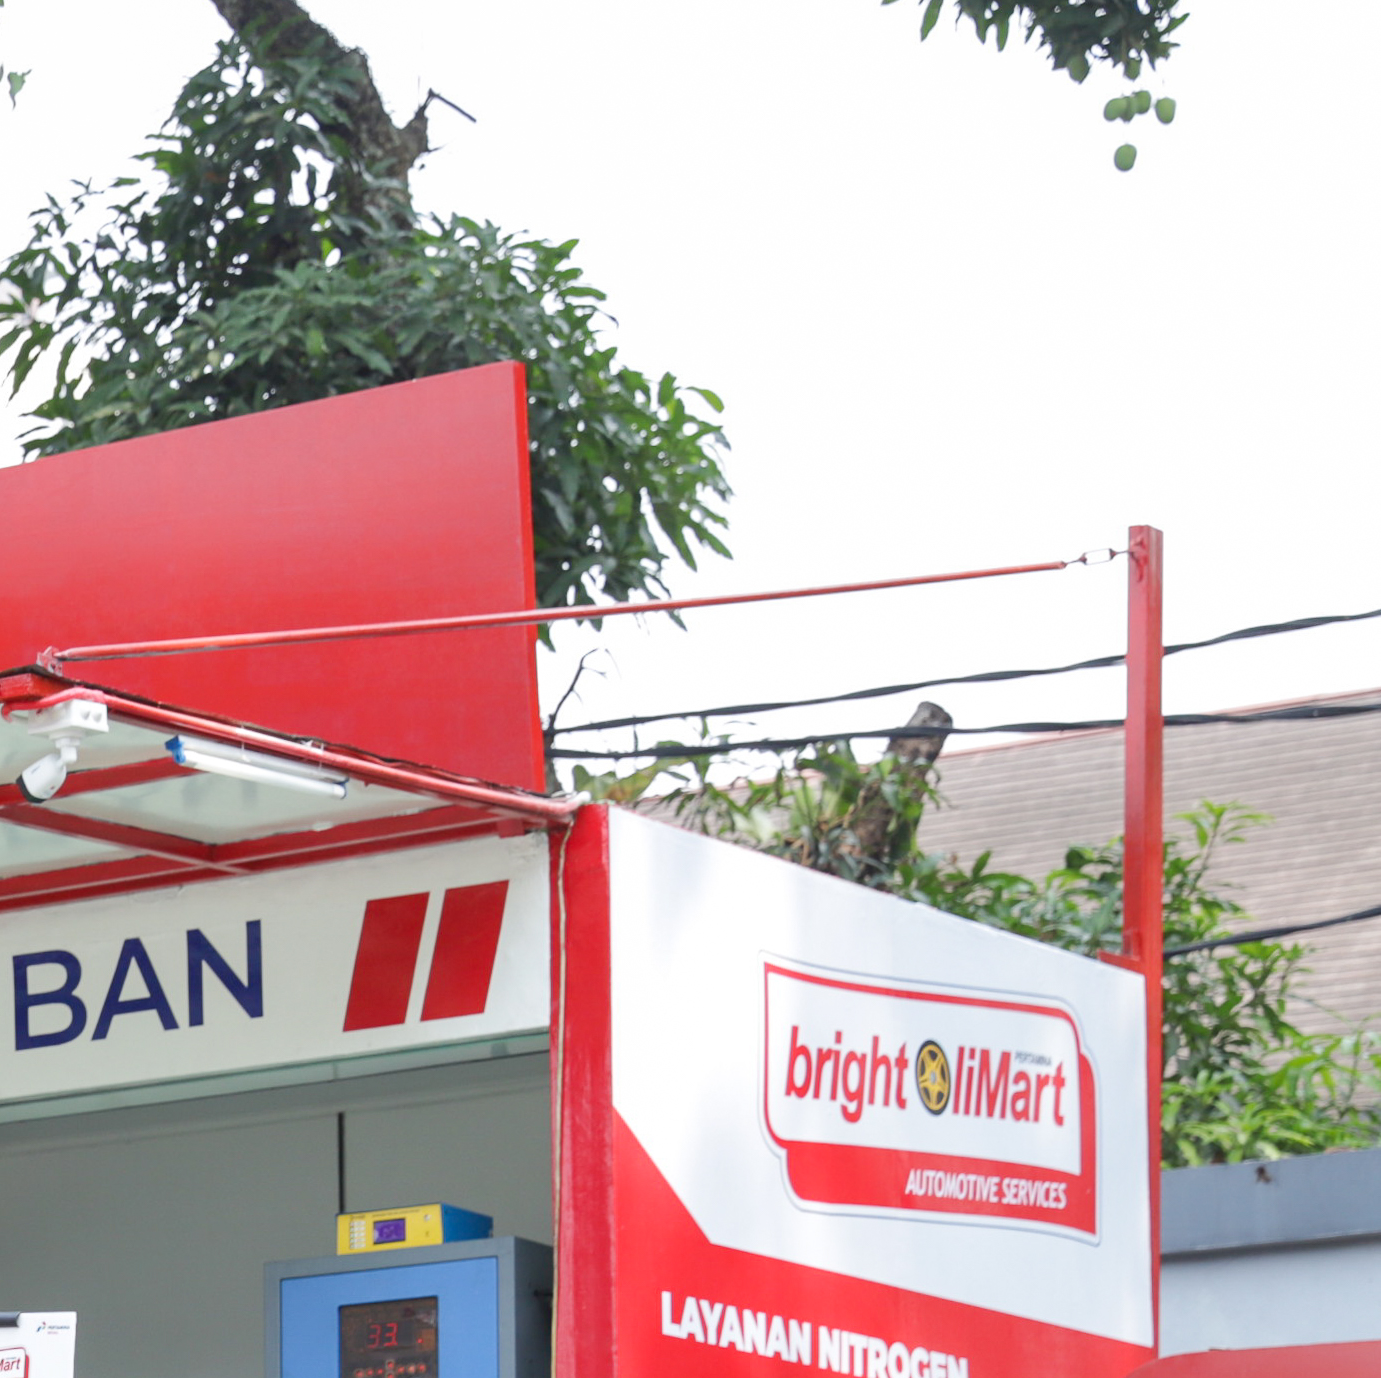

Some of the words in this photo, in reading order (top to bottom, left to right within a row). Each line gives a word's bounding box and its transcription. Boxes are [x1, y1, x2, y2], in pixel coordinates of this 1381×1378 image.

[12, 919, 264, 1052] BAN
[785, 1025, 909, 1124] bright
[905, 1169, 999, 1203] AUTOMOTIVE
[1001, 1178, 1067, 1210] SERVICES
[660, 1290, 812, 1366] LAYANAN
